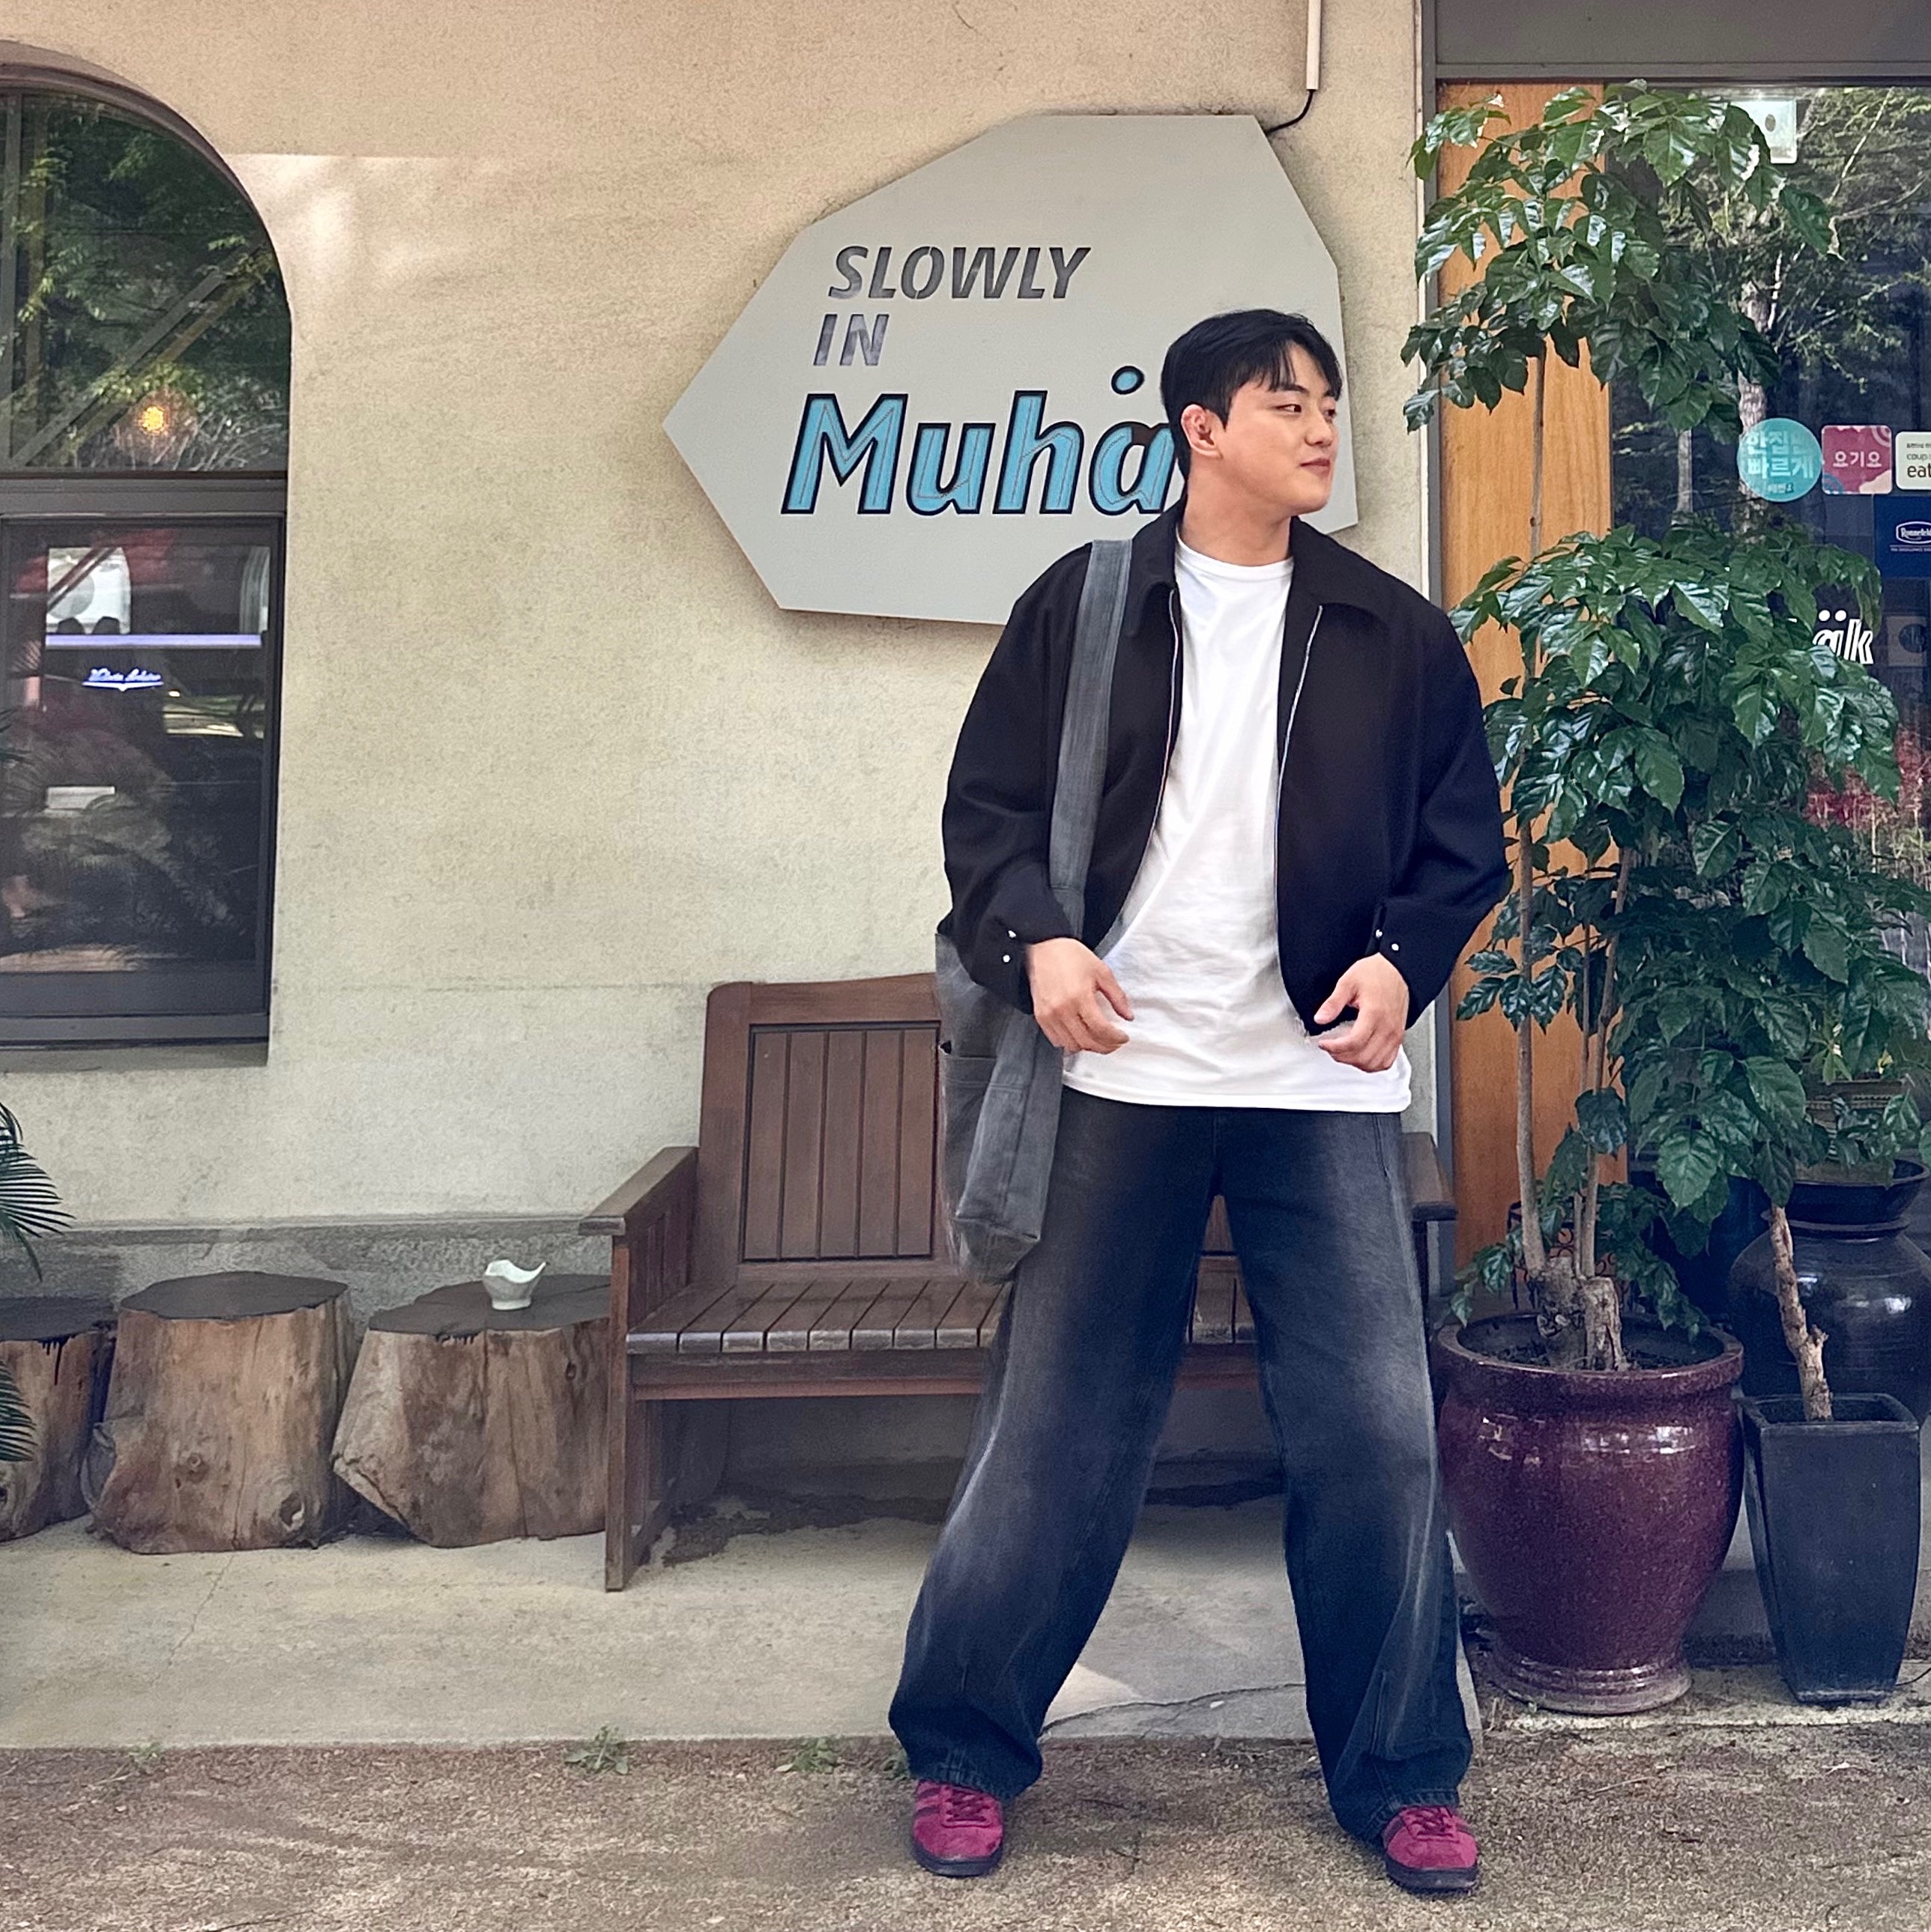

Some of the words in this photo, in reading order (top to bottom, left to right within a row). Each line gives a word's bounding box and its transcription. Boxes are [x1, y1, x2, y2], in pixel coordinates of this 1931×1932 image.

[828, 245, 1091, 300] SLOWLY
[813, 313, 889, 367] IN
[1747, 455, 1814, 480] 빠르게
[1832, 451, 1882, 468] 요기요
[1906, 453, 1931, 461] coup
